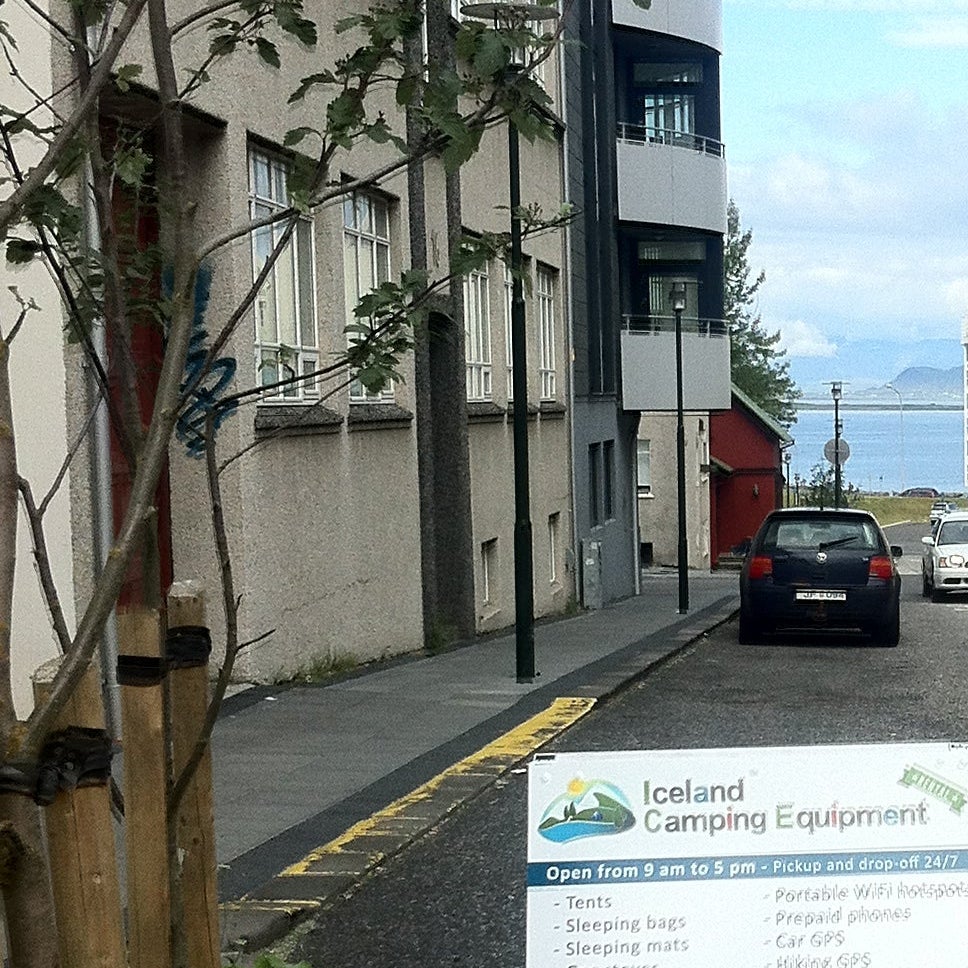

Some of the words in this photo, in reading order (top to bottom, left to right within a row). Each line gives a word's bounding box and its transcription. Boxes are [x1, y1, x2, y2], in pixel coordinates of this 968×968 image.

[643, 778, 745, 806] Iceland
[644, 807, 767, 837] Camping
[776, 800, 927, 835] Equipment
[546, 866, 592, 882] Open
[597, 864, 639, 878] from
[643, 862, 654, 877] 9
[659, 864, 685, 877] am
[690, 861, 709, 876] to
[713, 860, 724, 875] 5
[729, 862, 756, 878] pm
[773, 859, 822, 874] Pickup
[826, 857, 854, 871] and
[858, 856, 920, 874] drop-off
[924, 855, 959, 870] 24/7
[565, 895, 612, 910] Tents
[775, 884, 849, 903] Portable
[565, 916, 641, 934] Sleeping
[646, 914, 687, 932] bags
[775, 907, 842, 928] Prepaid
[847, 905, 912, 927] phones
[565, 939, 641, 957] Sleeping
[646, 938, 690, 953] mats
[775, 932, 805, 949] Car
[810, 930, 846, 948] GPS
